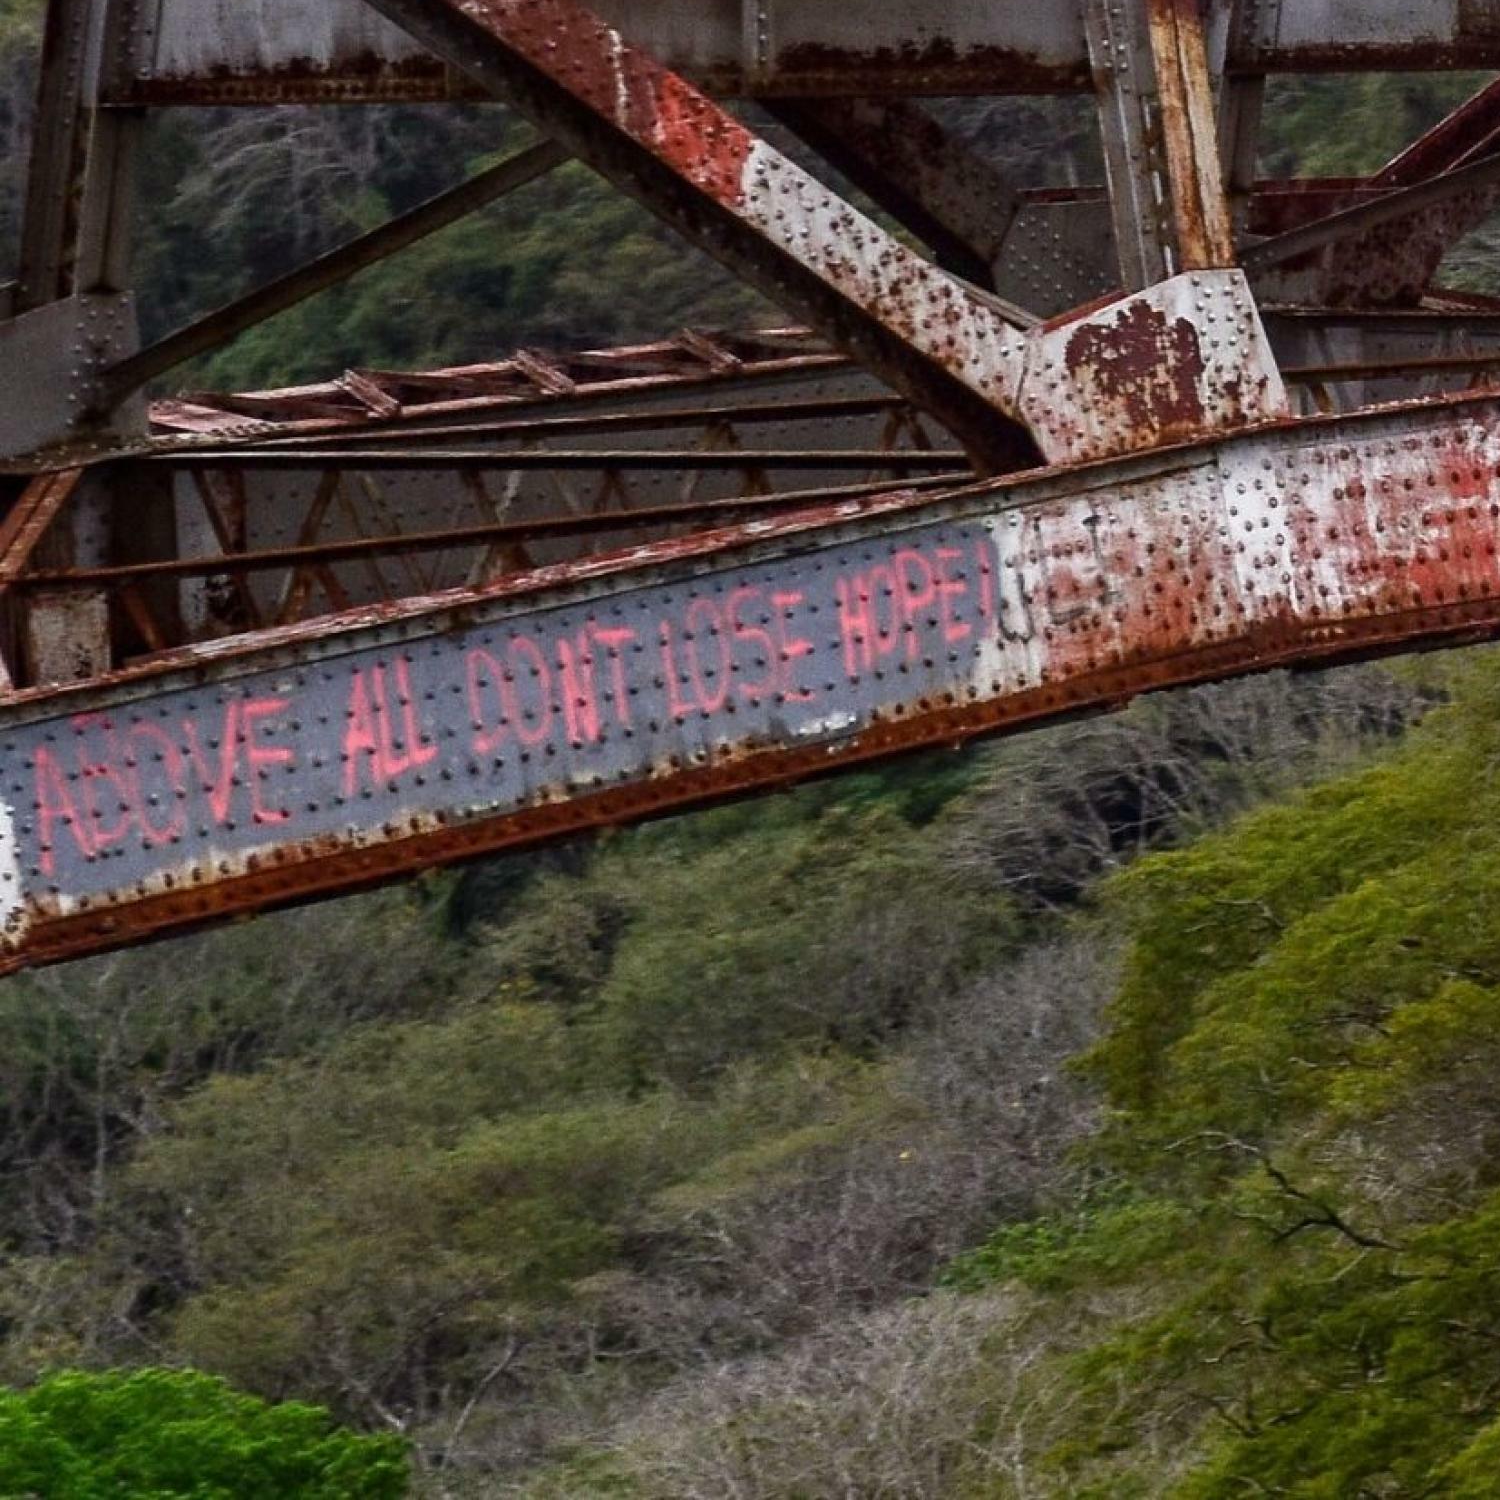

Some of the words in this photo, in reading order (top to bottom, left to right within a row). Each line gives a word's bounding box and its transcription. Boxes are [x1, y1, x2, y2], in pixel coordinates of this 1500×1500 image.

[33, 698, 295, 877] ABOVE
[342, 653, 439, 797] ALL
[660, 587, 815, 717] LOSE
